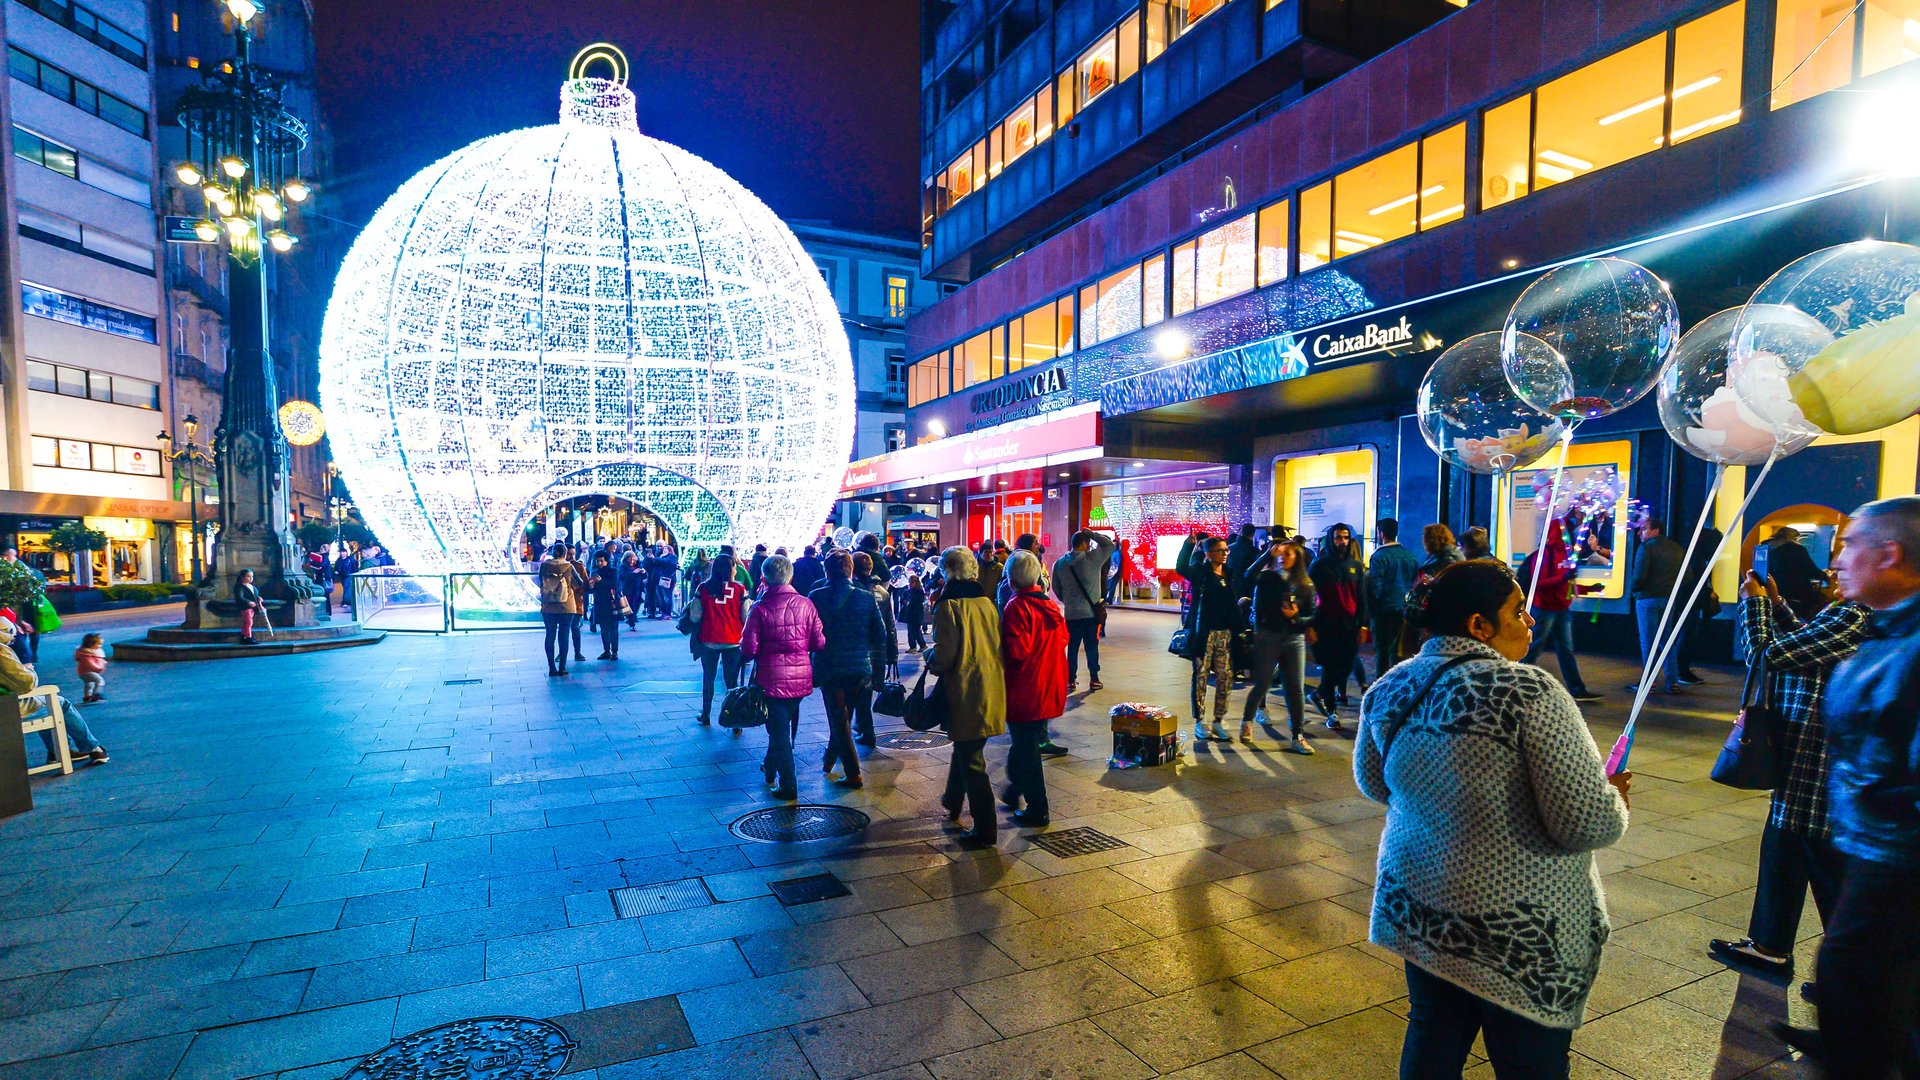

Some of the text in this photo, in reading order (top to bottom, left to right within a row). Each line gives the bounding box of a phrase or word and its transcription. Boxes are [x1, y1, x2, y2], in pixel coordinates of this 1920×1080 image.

[1313, 316, 1413, 359] CaixaBank
[971, 367, 1065, 415] ORTODONCIA
[975, 438, 1020, 462] Santander
[104, 503, 138, 513] GENERAL
